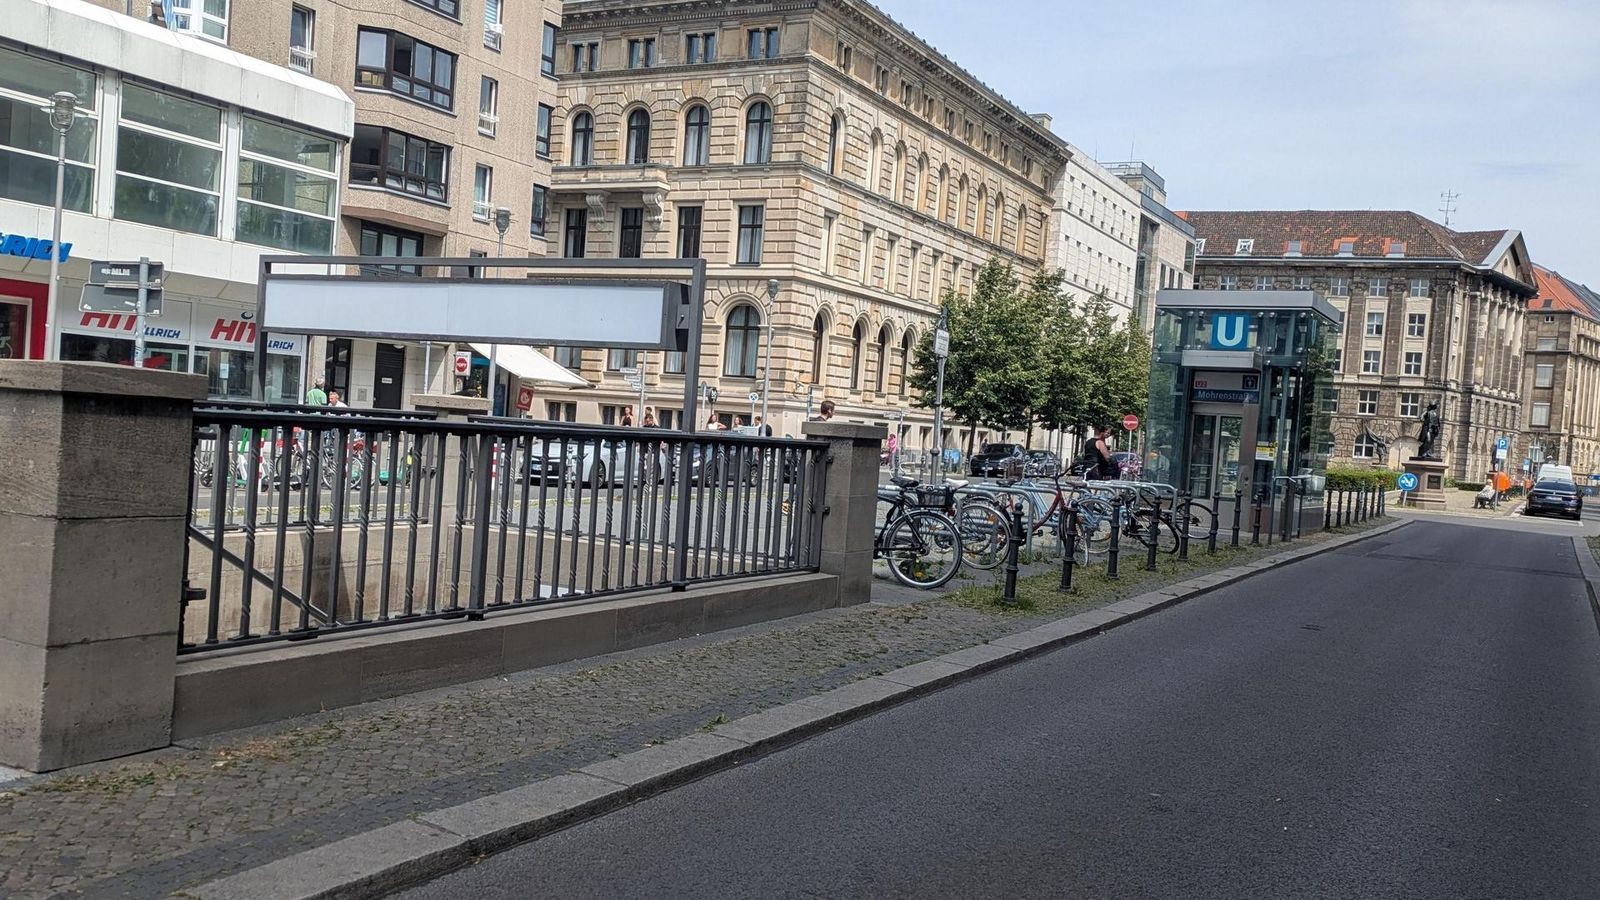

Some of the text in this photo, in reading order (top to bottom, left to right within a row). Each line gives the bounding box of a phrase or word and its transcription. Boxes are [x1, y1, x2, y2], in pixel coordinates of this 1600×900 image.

[144, 326, 181, 339] LLRICH
[1217, 316, 1244, 347] U
[268, 340, 294, 351] LRICH
